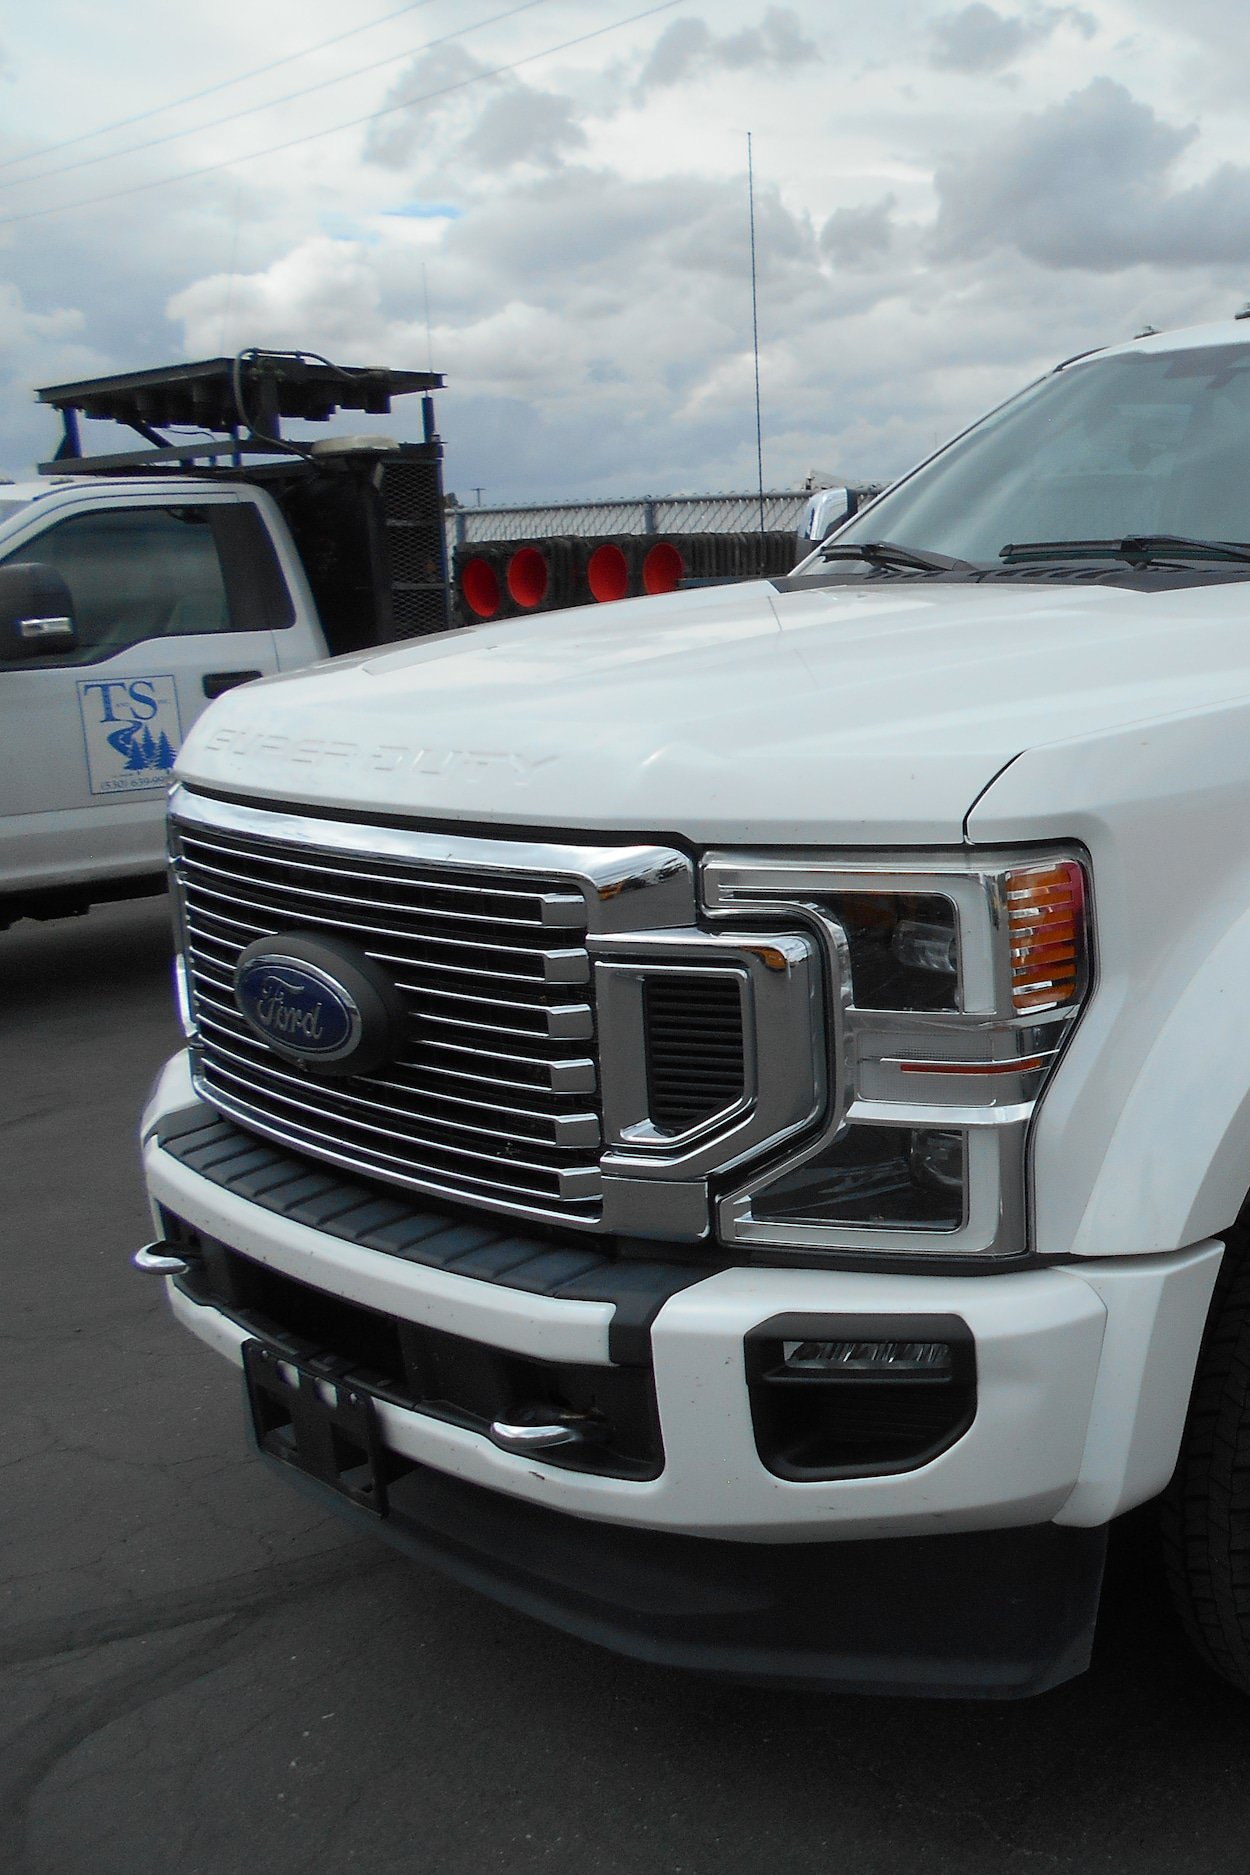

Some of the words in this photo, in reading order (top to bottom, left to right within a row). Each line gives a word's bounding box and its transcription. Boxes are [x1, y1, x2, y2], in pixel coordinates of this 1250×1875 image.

[205, 729, 358, 765] SUPER
[371, 744, 561, 787] DUTY
[256, 975, 324, 1040] Ford
